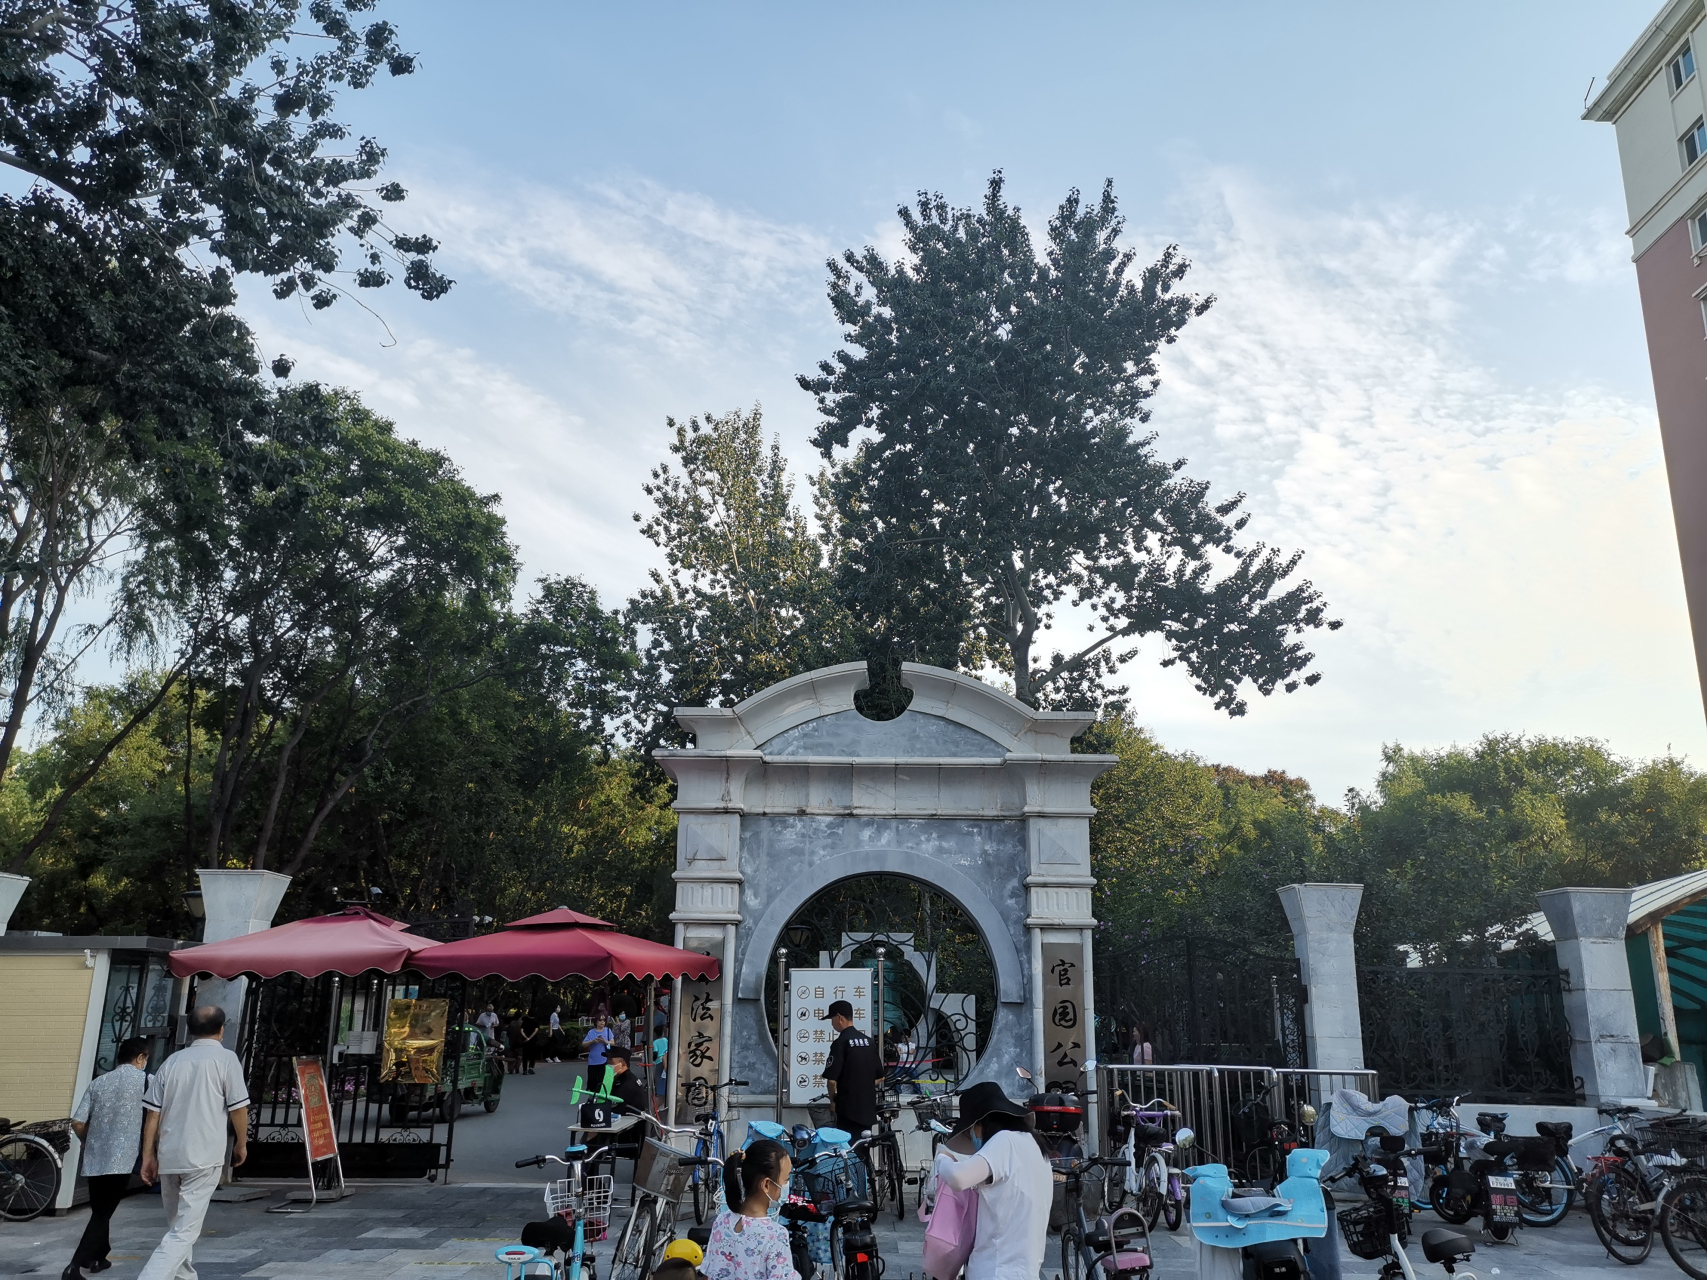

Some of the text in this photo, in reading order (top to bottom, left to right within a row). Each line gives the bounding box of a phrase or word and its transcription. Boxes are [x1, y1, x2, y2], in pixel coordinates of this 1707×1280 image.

[814, 985, 866, 999] 自行车
[813, 1007, 866, 1021] 电车
[685, 951, 714, 1107] 法家园
